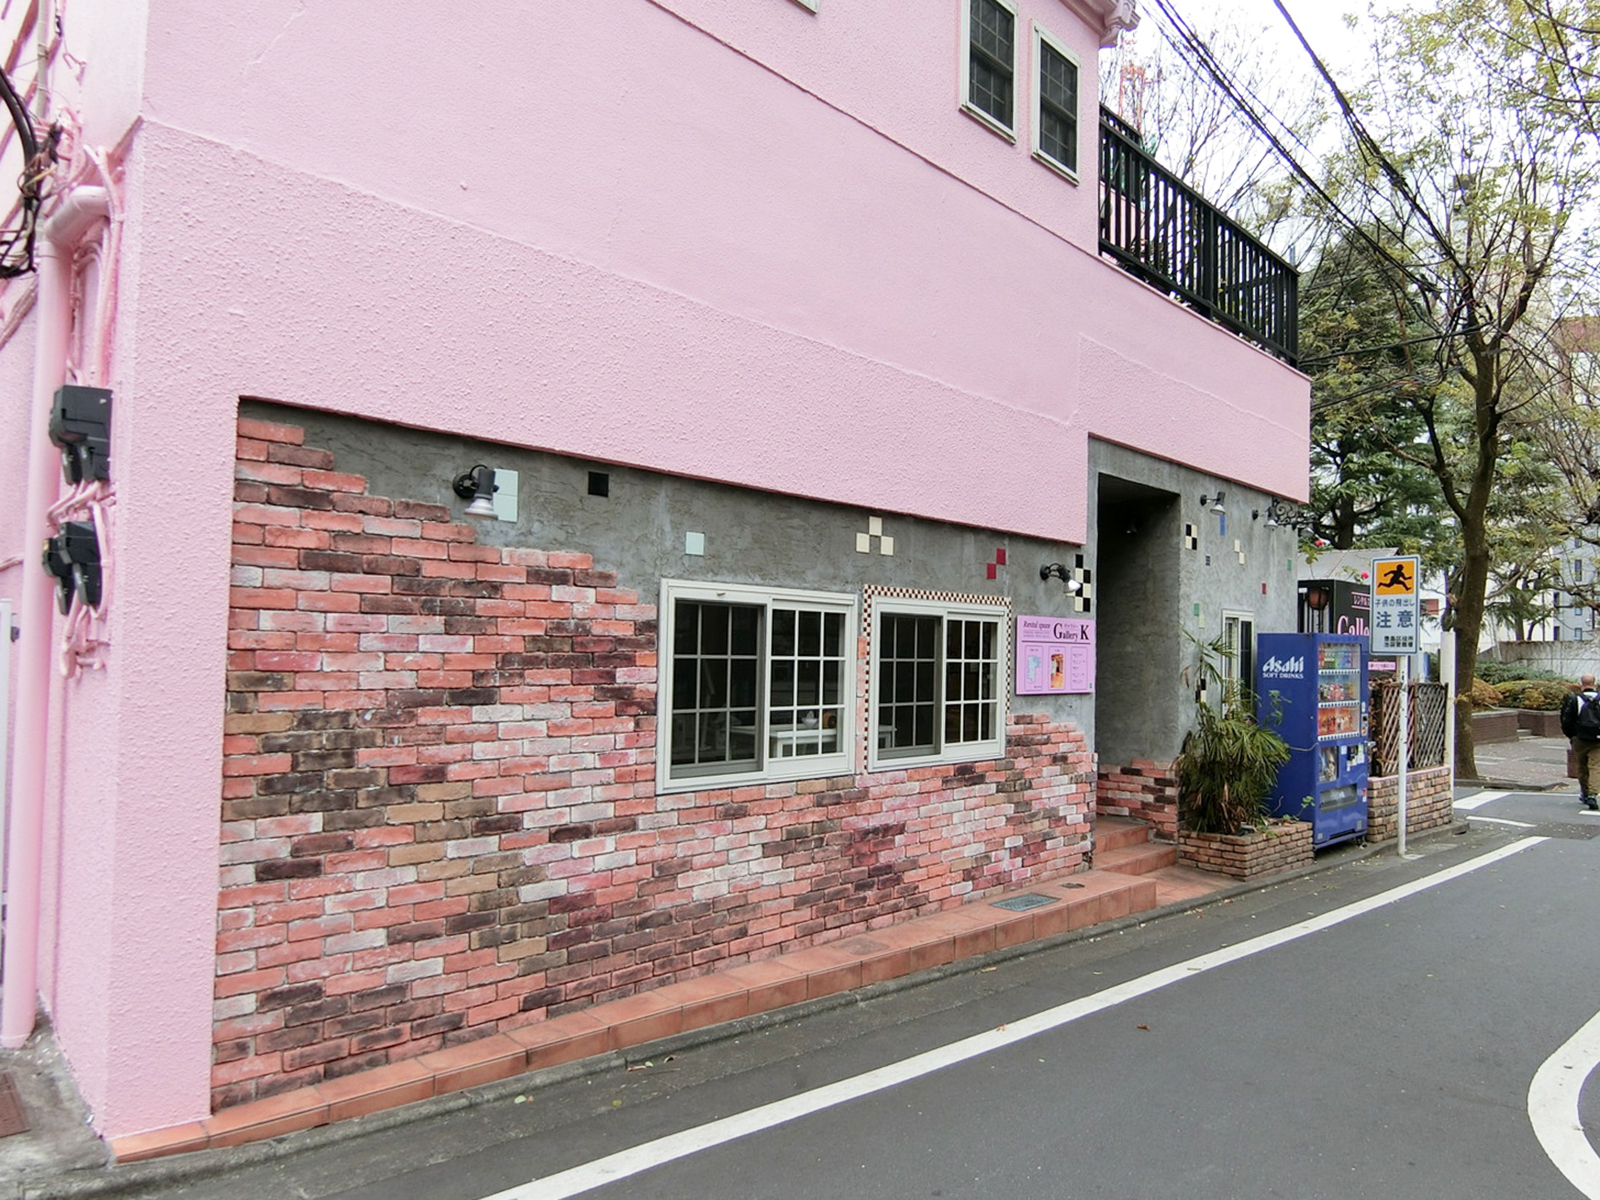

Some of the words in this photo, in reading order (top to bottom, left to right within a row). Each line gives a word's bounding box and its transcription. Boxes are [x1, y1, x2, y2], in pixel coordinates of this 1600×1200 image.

[1375, 598, 1415, 607] 子供の飛出し
[1337, 615, 1370, 636] Galle
[1376, 610, 1414, 628] 注意
[1053, 623, 1078, 642] Gallery
[1080, 624, 1089, 640] K
[1262, 655, 1304, 672] Asahi
